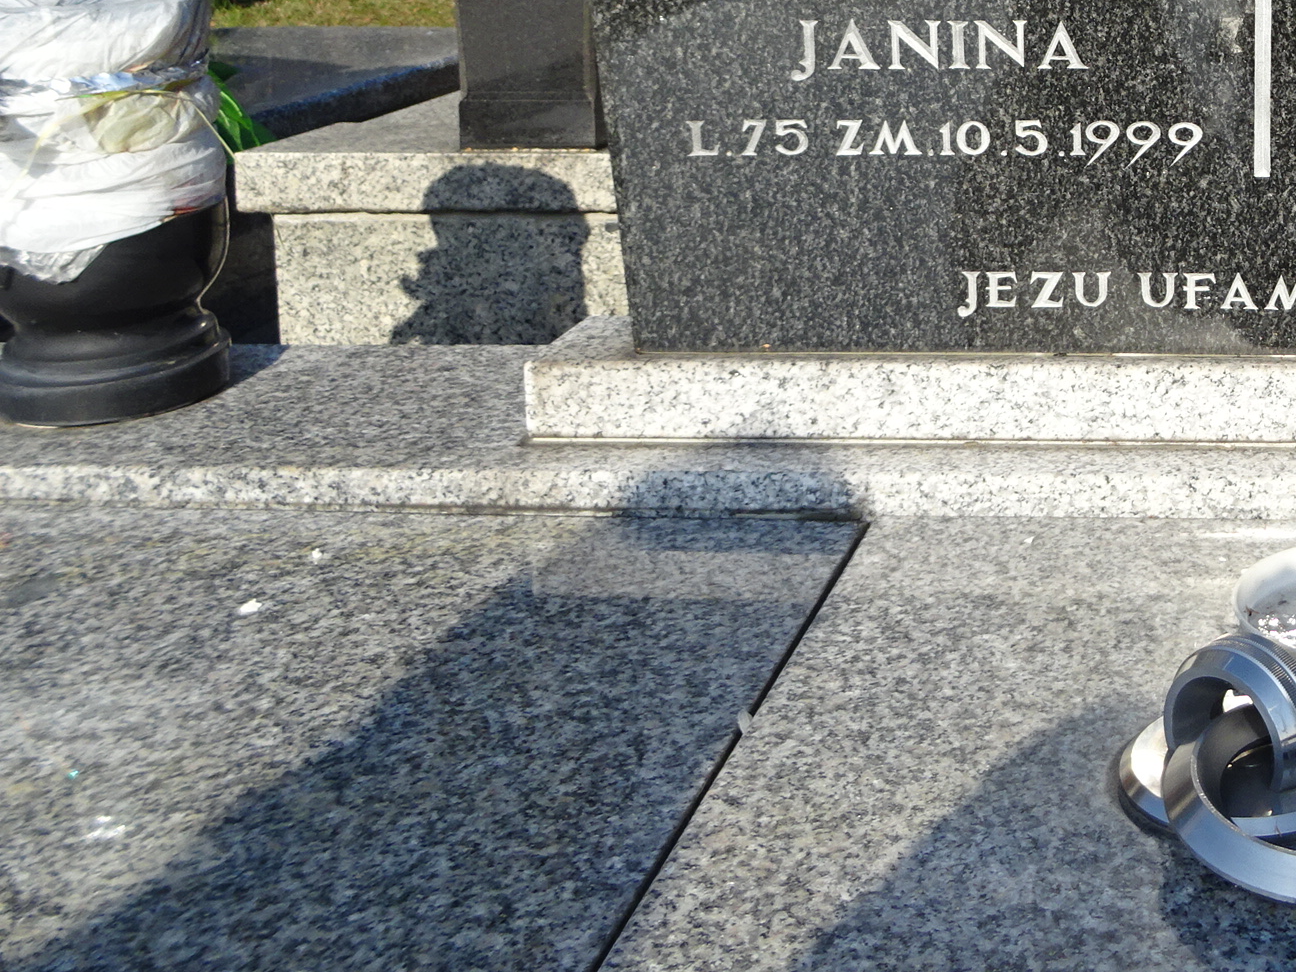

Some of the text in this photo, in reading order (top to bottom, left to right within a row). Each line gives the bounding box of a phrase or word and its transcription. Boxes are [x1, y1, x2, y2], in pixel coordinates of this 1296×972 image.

[789, 17, 1090, 82] JANINA
[685, 118, 809, 158] L.75
[956, 268, 1112, 320] JEZU
